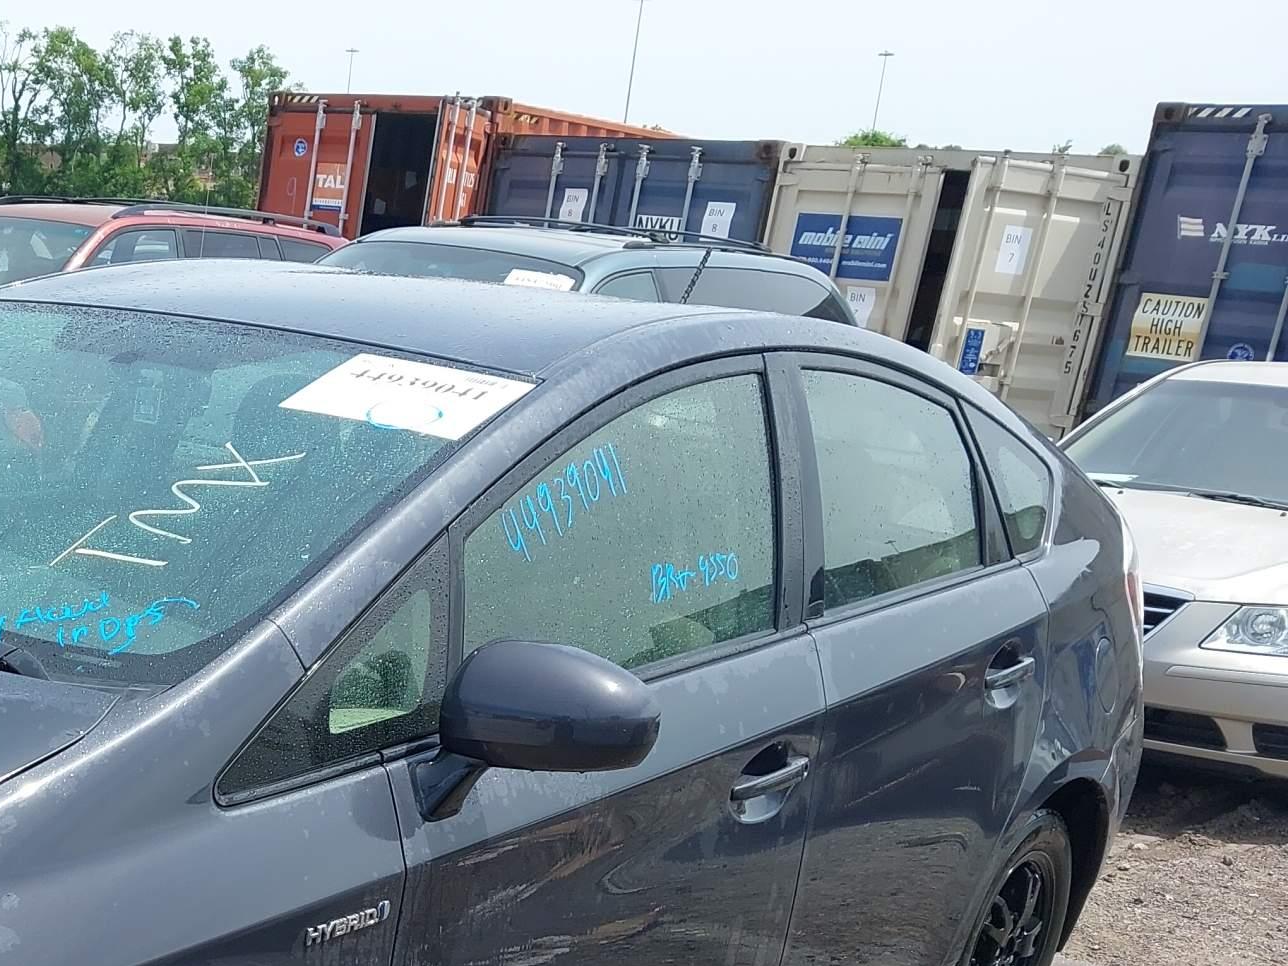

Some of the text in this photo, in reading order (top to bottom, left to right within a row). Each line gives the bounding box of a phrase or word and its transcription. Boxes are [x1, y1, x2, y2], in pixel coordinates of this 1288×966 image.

[316, 174, 345, 189] TAL
[708, 208, 725, 217] BIN
[1005, 233, 1023, 246] BIN
[1210, 222, 1277, 241] NYK
[1008, 252, 1015, 263] 7
[850, 292, 866, 303] BIN
[1142, 297, 1206, 319] CAUTION
[1149, 317, 1183, 337] HIGH
[1134, 335, 1194, 358] TRAILER
[48, 441, 307, 567] TMX
[502, 442, 628, 562] 44939041
[304, 906, 379, 947] HYBRID
